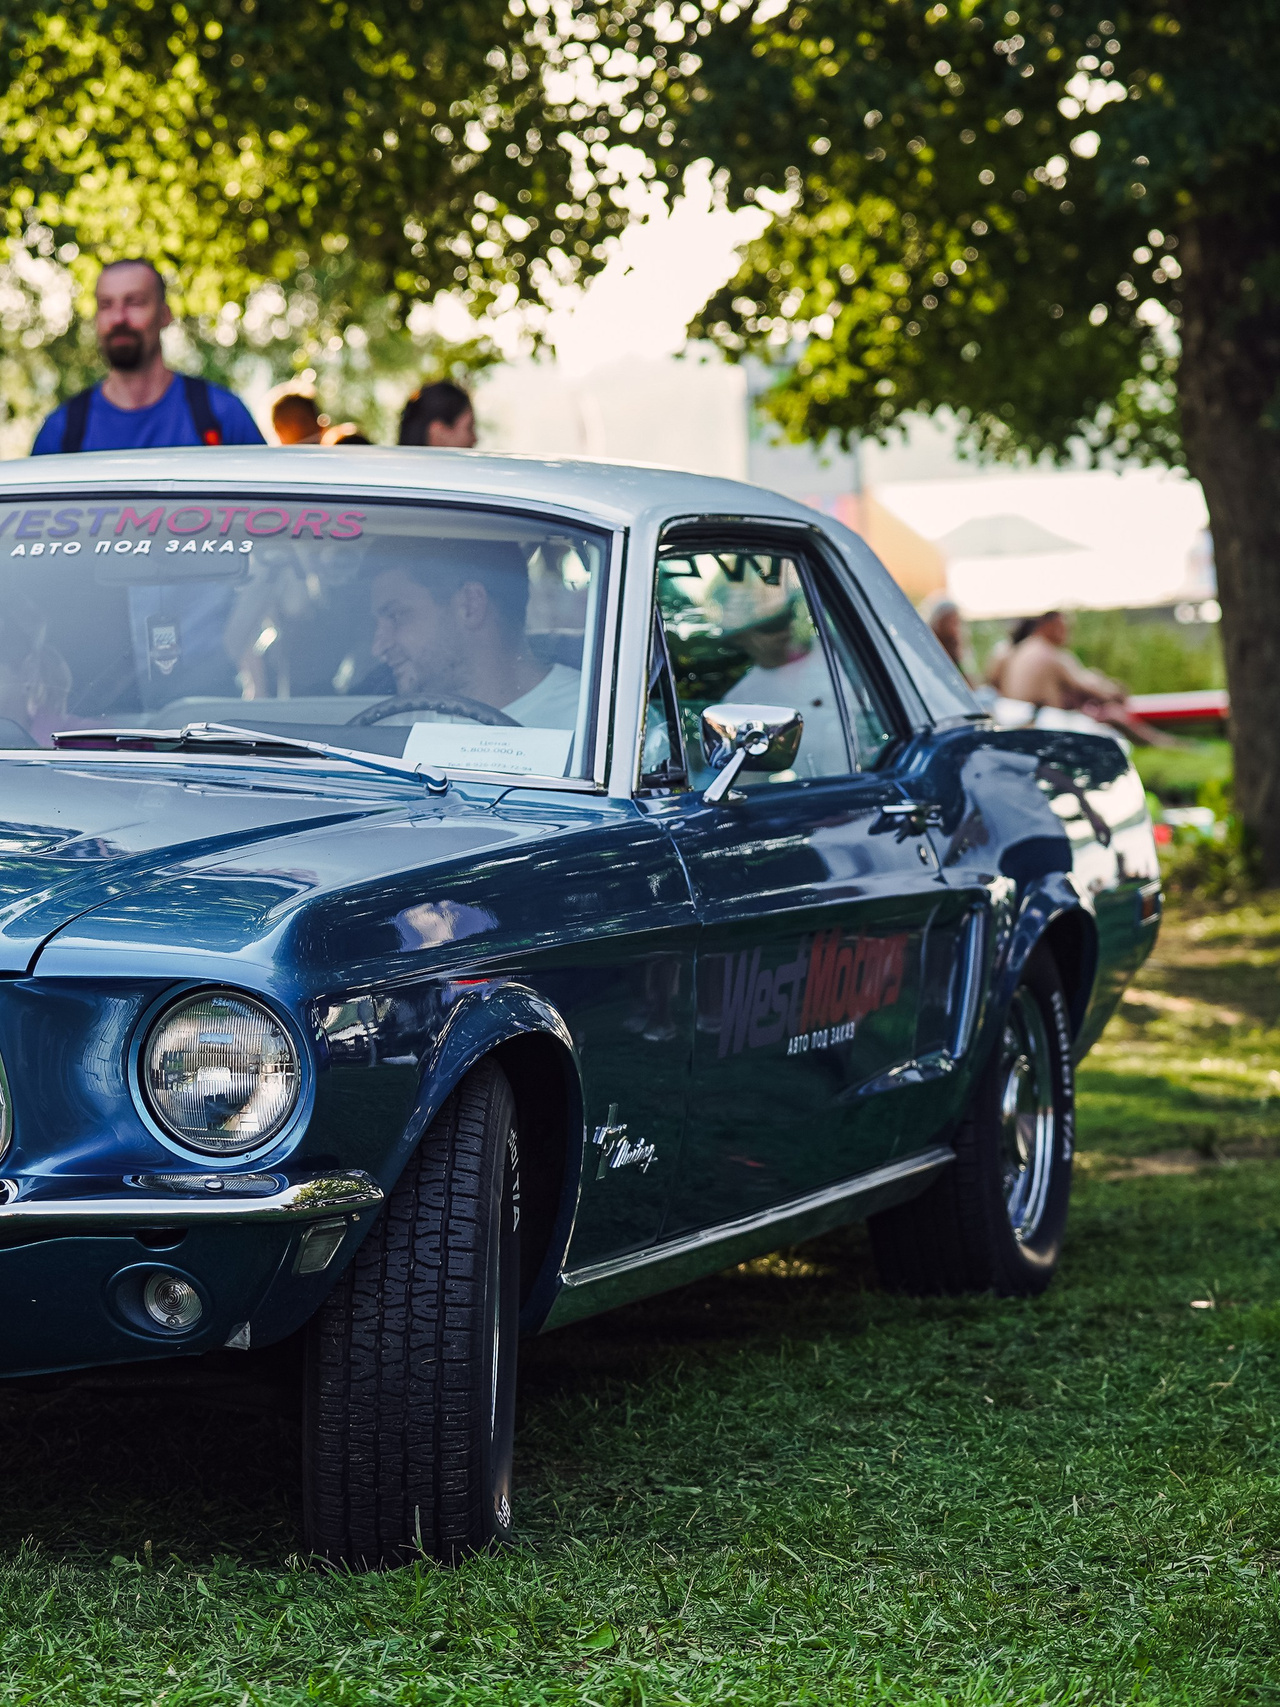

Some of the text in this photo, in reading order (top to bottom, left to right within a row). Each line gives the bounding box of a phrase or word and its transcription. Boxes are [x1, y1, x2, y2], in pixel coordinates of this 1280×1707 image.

[10, 538, 255, 558] АВТО ПОД ЗАКАЗ
